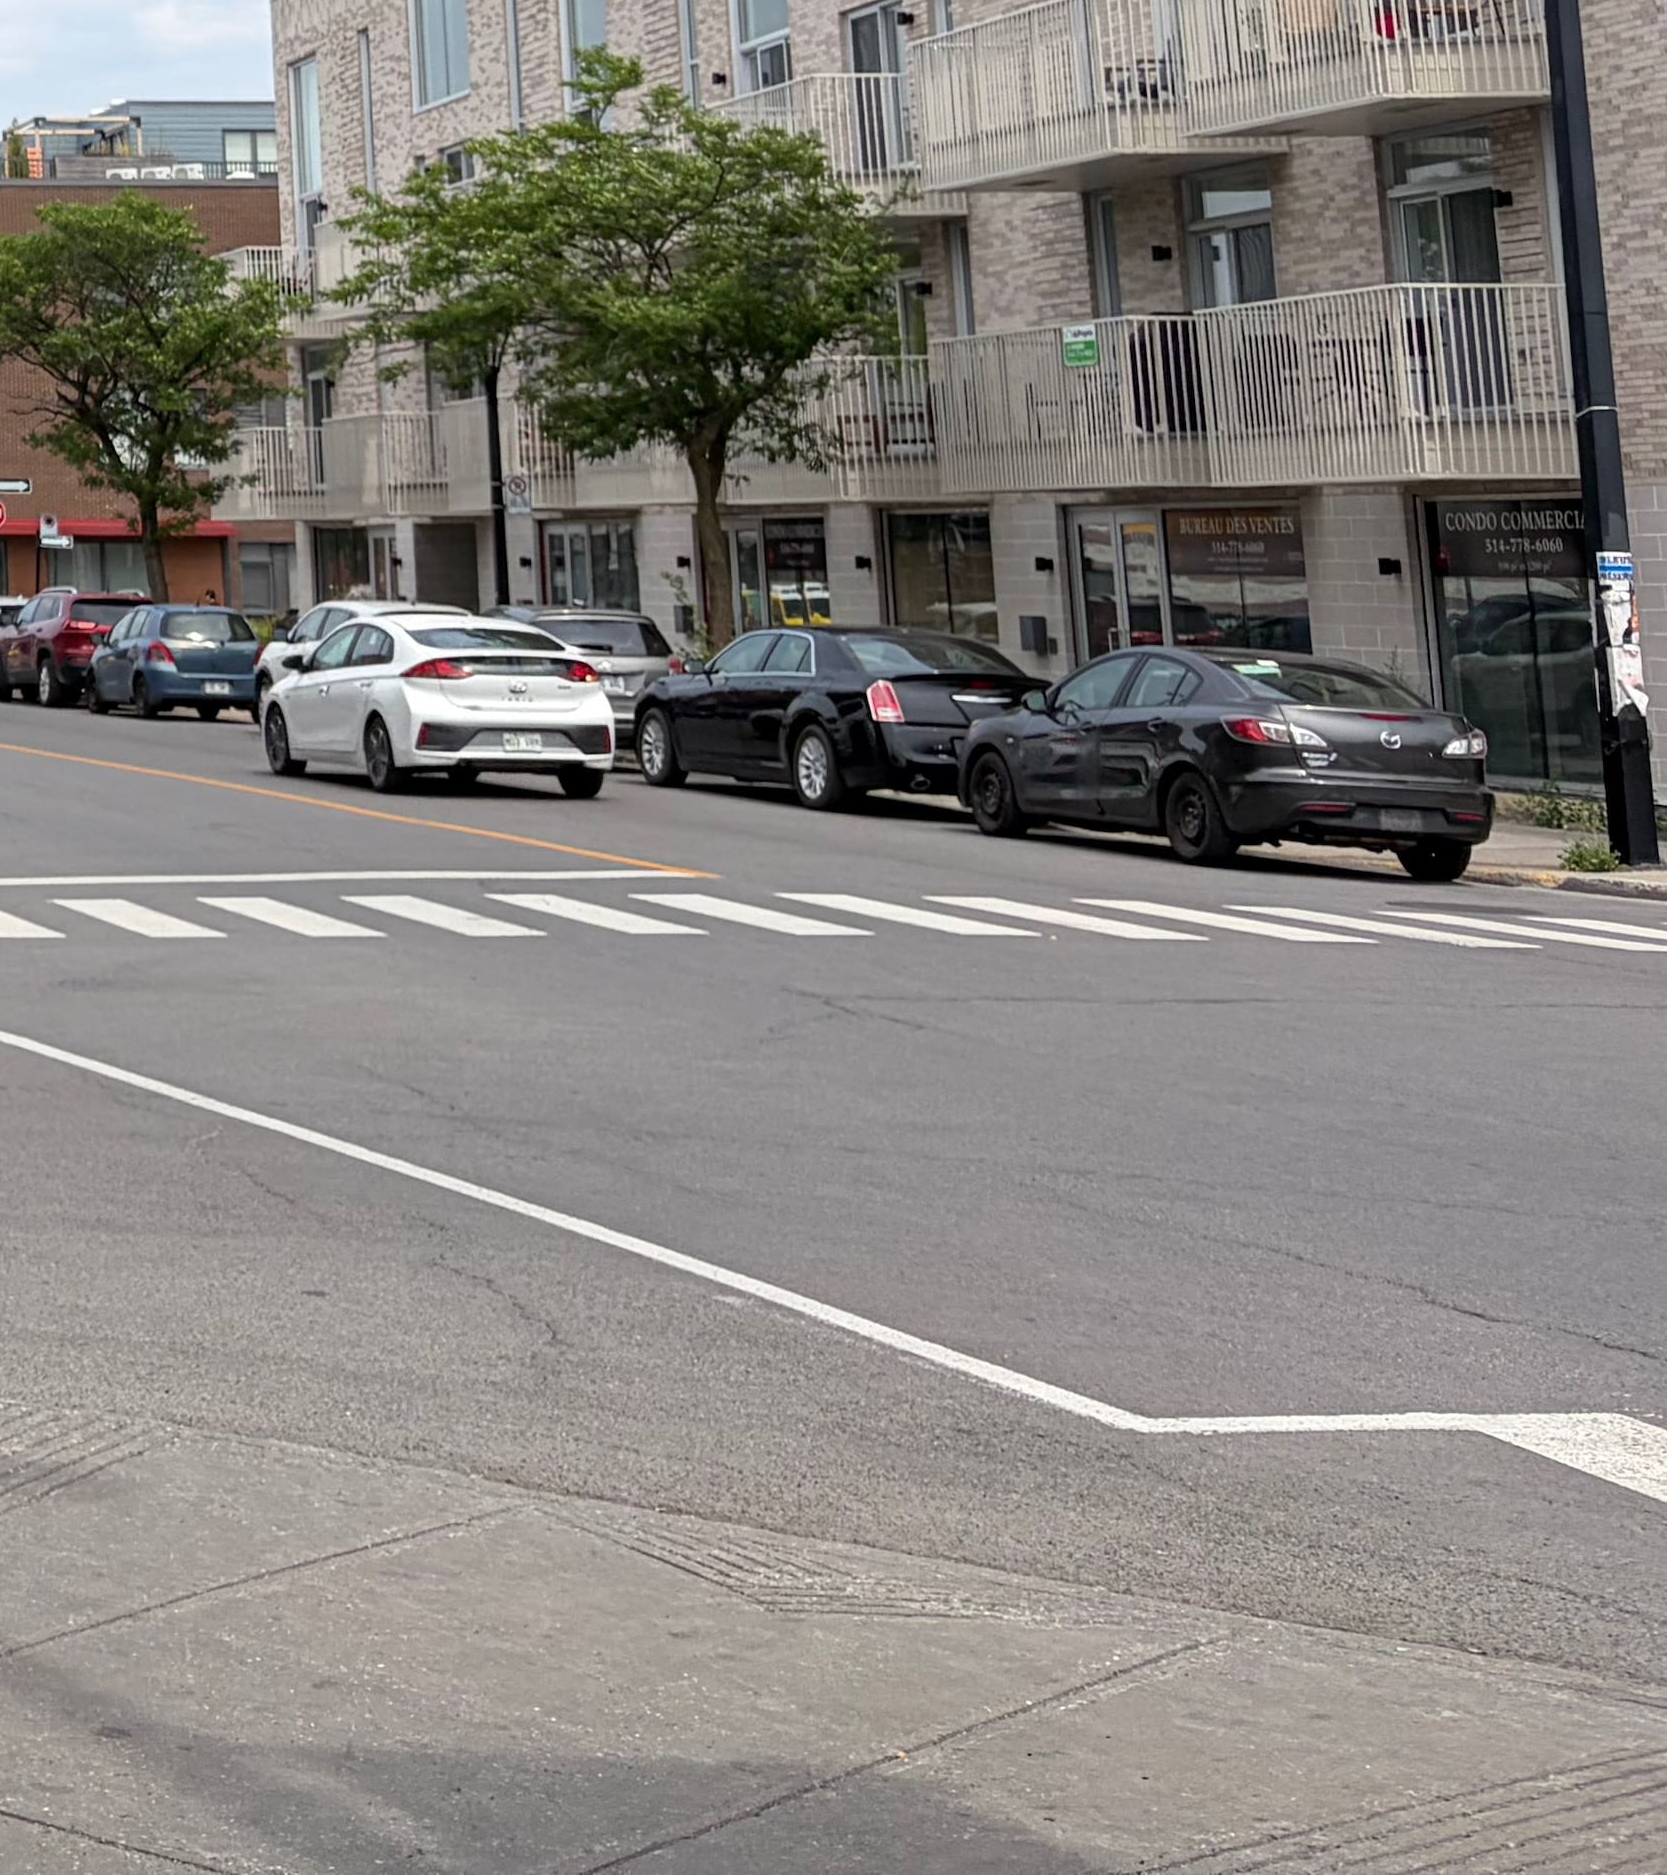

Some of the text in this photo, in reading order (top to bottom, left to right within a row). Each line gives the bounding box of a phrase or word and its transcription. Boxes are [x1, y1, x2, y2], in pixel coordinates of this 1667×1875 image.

[1178, 516, 1295, 535] BUREAU DES VENTES
[1445, 511, 1497, 532] CONDO
[1485, 537, 1564, 554] 514-778-6060
